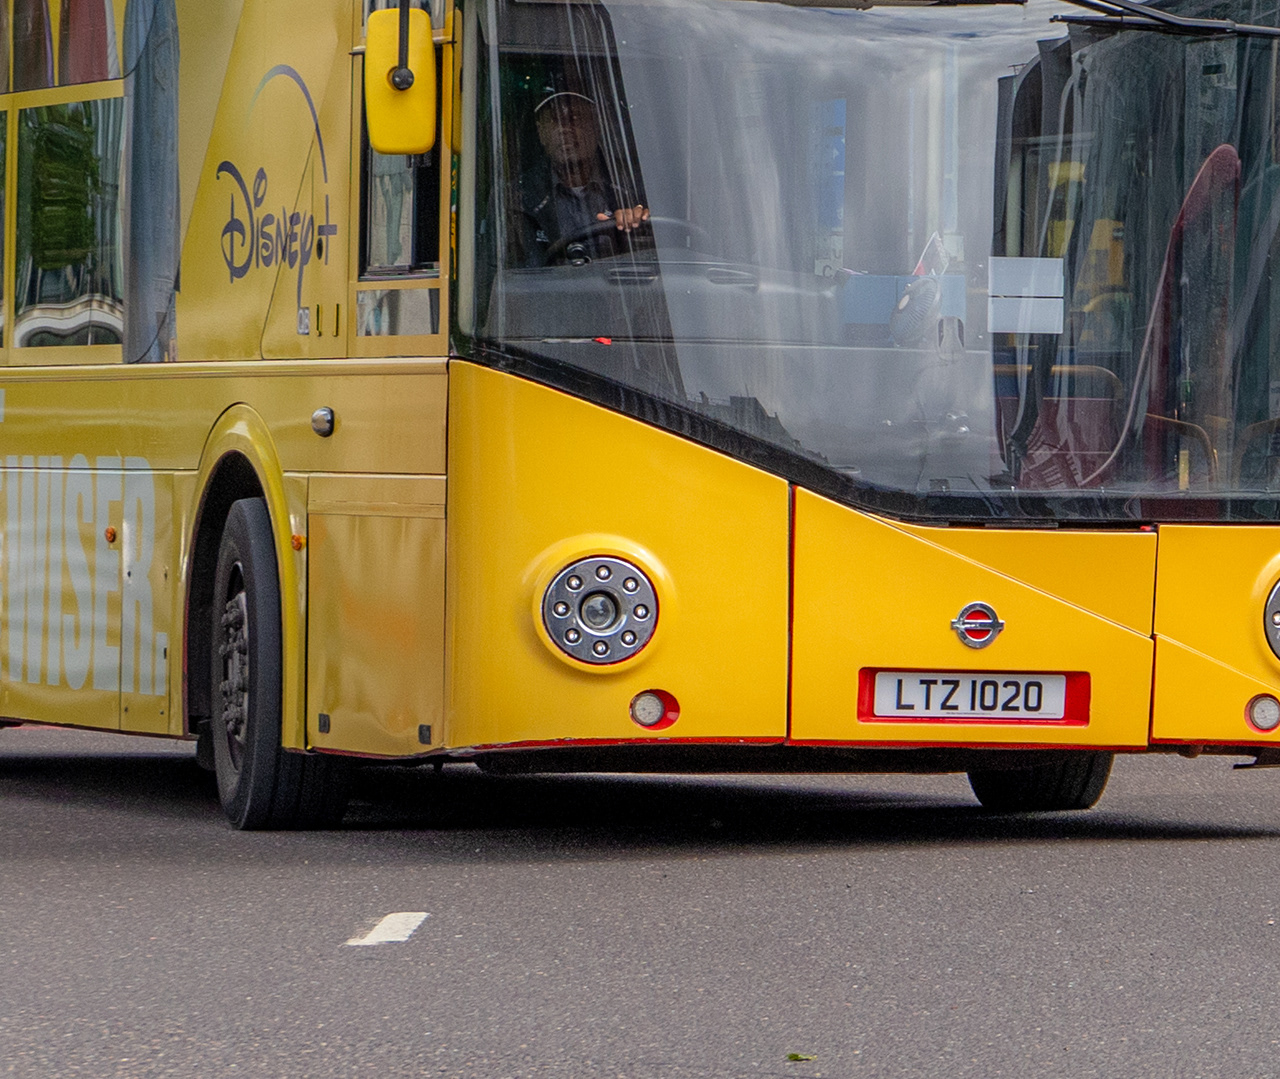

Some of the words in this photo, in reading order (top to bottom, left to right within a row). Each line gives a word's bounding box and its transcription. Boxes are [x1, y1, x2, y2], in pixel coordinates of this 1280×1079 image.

[5, 452, 168, 697] WISER.
[896, 678, 961, 711] LTZ
[970, 679, 1043, 712] 1020
